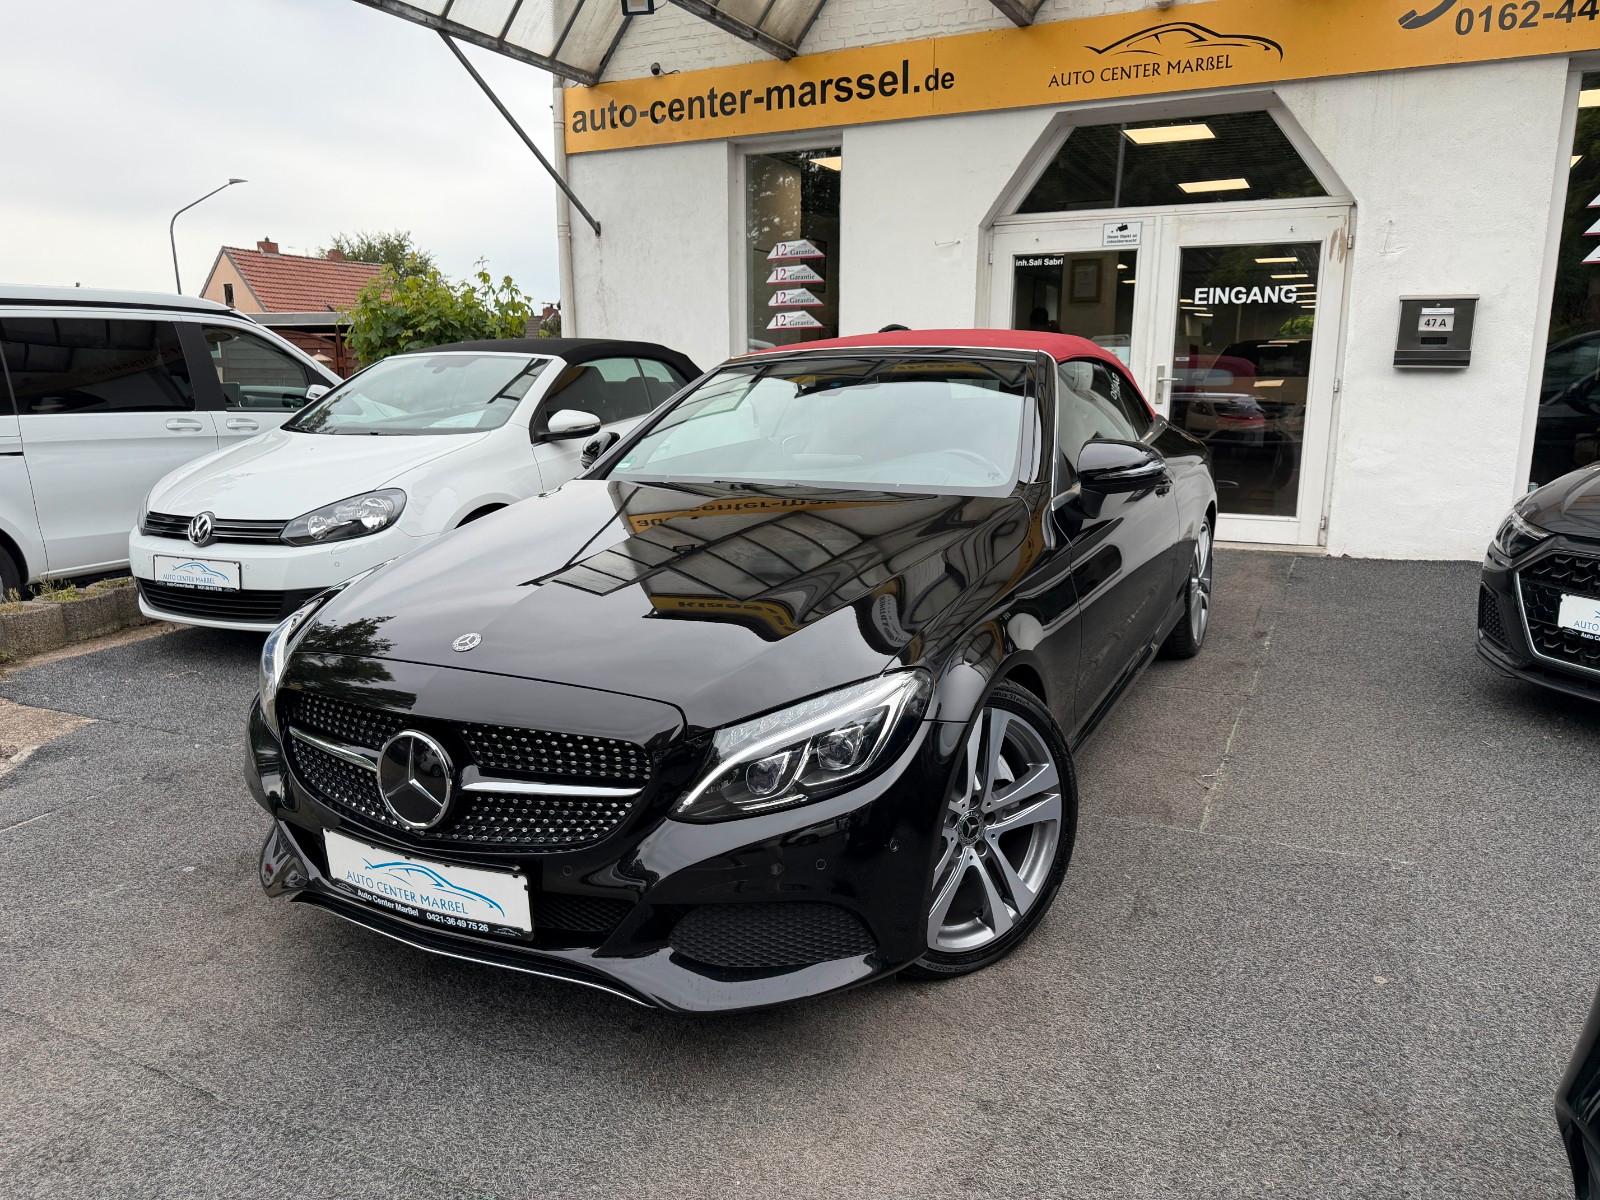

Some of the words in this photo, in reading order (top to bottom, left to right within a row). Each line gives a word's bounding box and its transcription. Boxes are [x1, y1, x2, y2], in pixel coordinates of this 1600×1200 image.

[1048, 70, 1095, 88] AUTO
[1100, 62, 1161, 82] CENTER
[572, 59, 955, 133] auto-center-marssel.de
[775, 243, 787, 256] 12
[774, 268, 787, 281] 12
[774, 291, 787, 304] 12
[1193, 286, 1298, 305] EINGANG
[774, 314, 787, 327] 12
[1424, 318, 1437, 327] 47
[1438, 318, 1447, 327] A
[1574, 620, 1599, 631] AUTO
[346, 869, 374, 889] AUTO
[376, 881, 418, 904] CENTER
[357, 888, 372, 901] Auto
[372, 894, 395, 909] Center
[426, 911, 456, 926] 0421-36
[456, 919, 467, 928] 49
[467, 920, 478, 930] 75
[478, 922, 489, 933] 26
